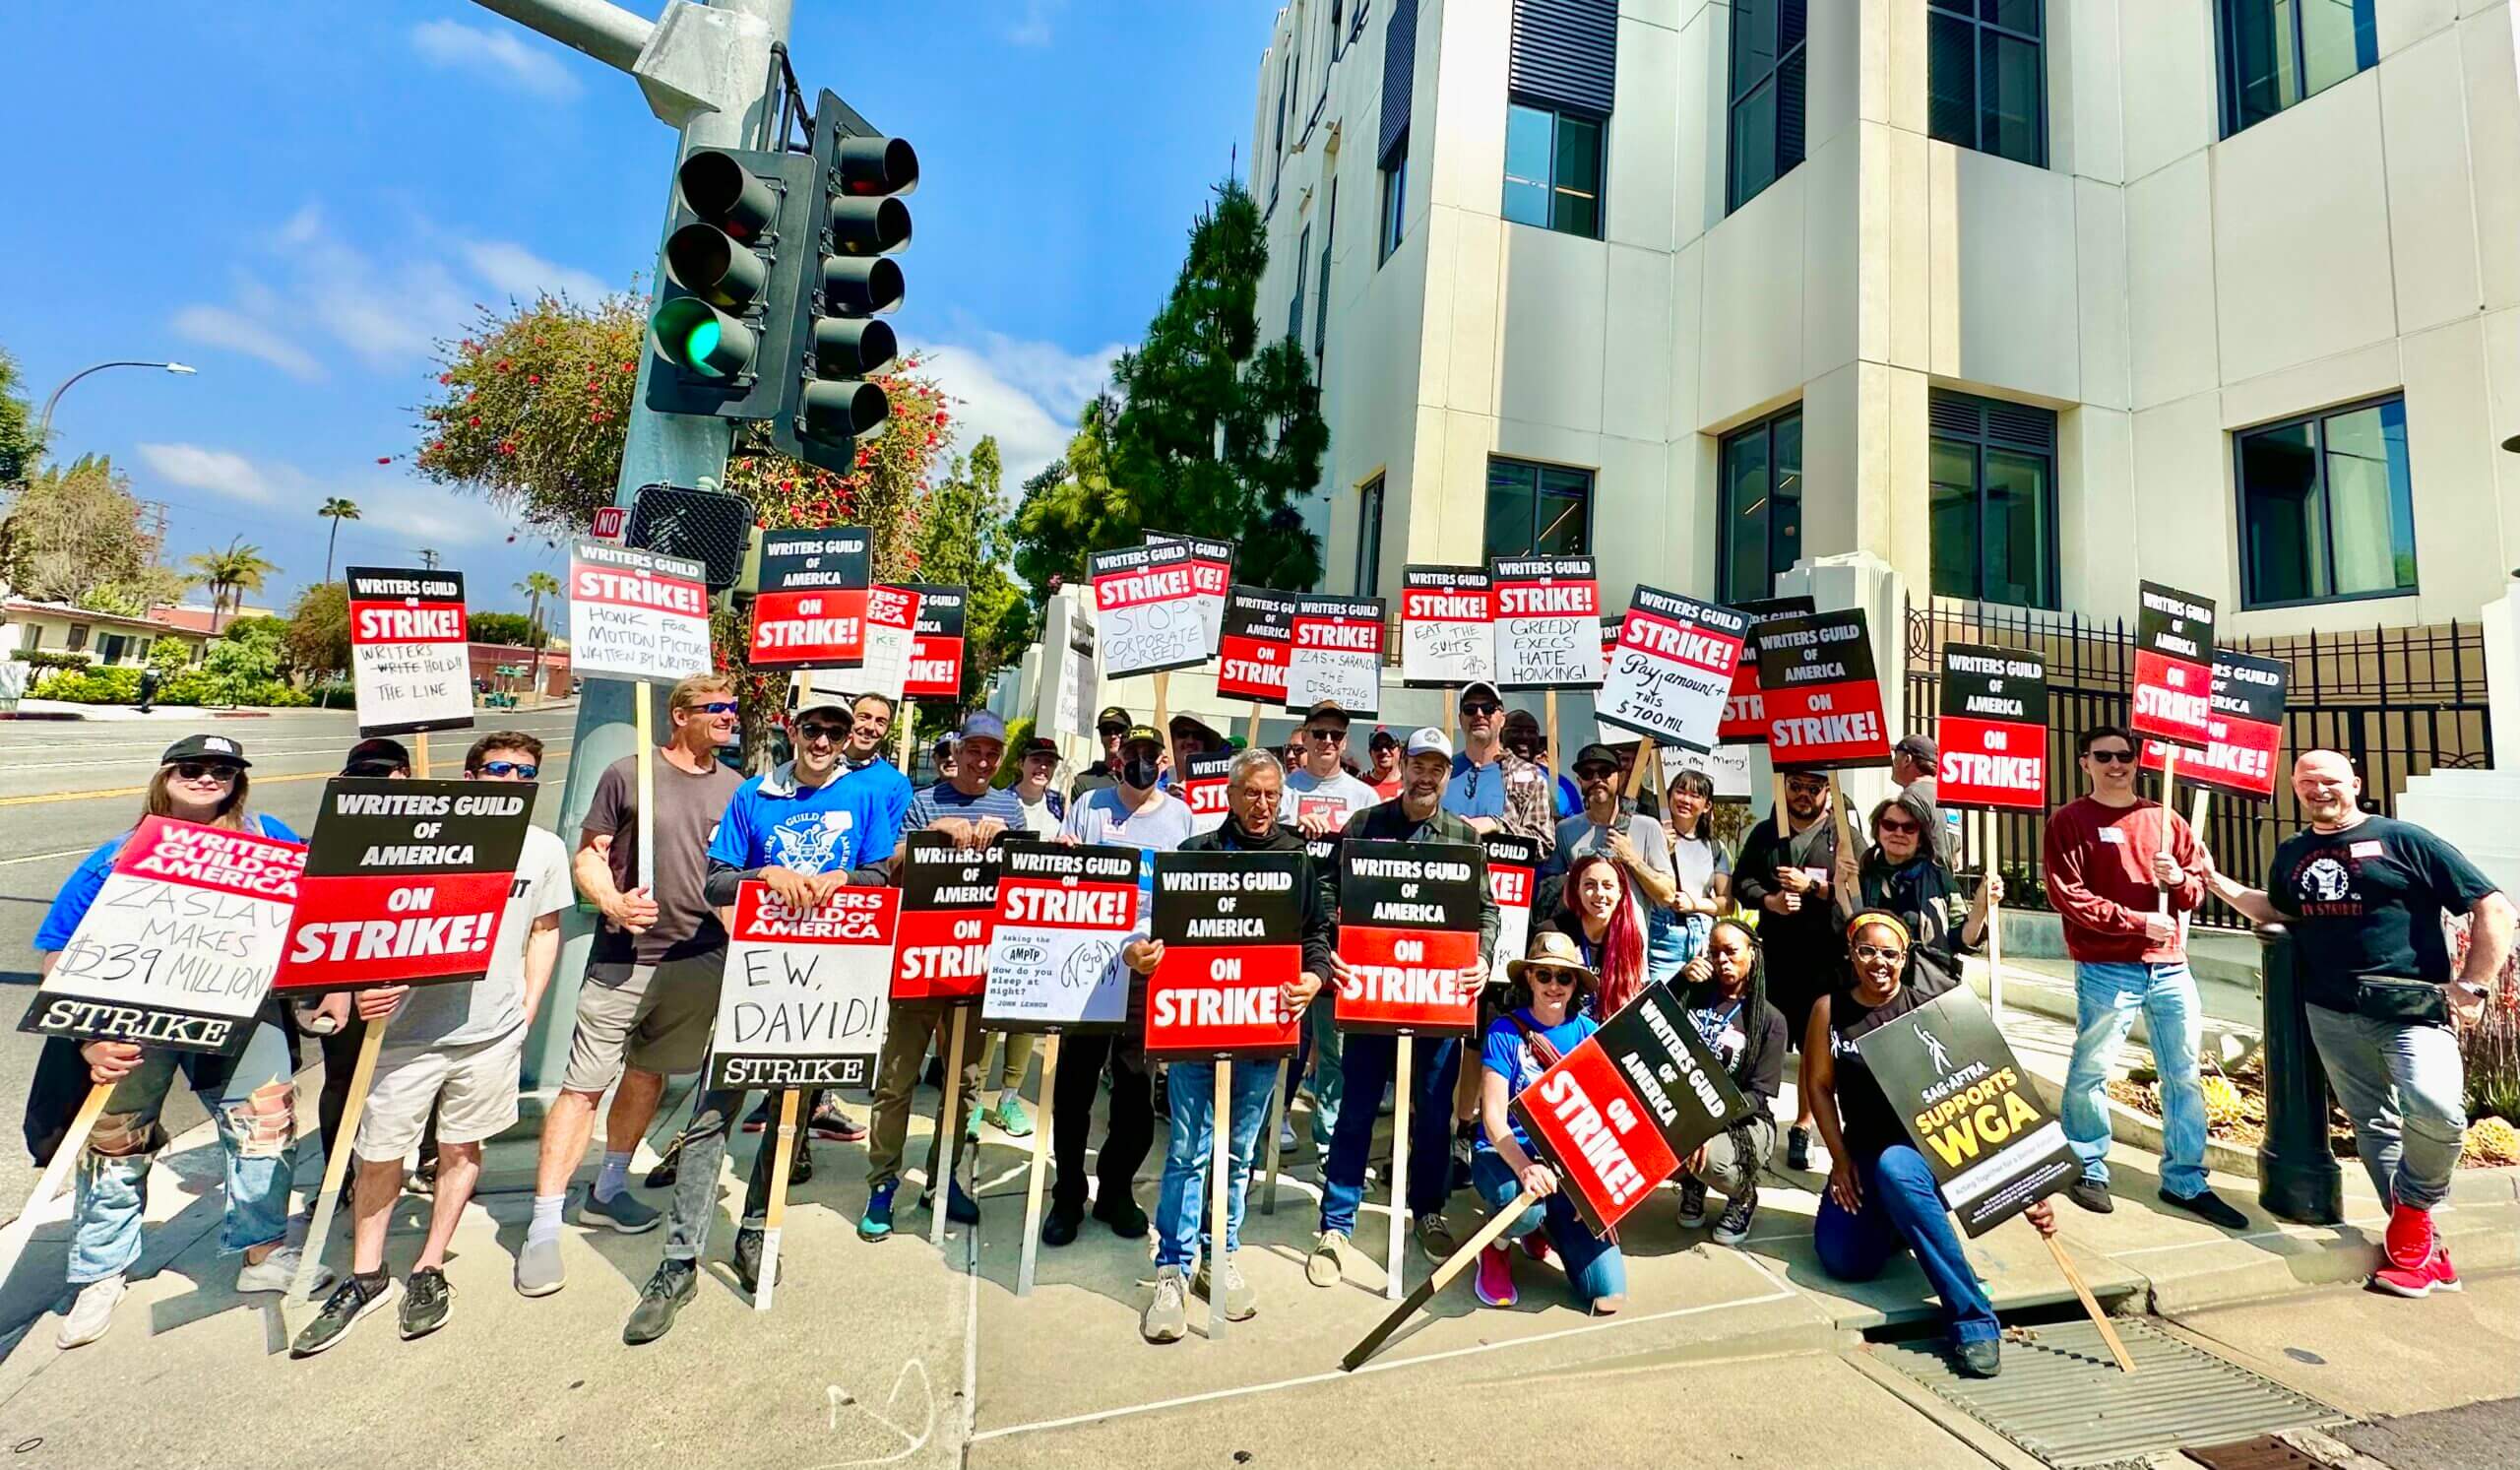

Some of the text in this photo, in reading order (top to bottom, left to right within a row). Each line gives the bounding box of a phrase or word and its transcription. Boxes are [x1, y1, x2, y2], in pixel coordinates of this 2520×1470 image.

[598, 512, 619, 534] NO
[767, 540, 863, 556] WRITERS GUILD
[1096, 545, 1186, 570] WRITERS GUILD
[1195, 543, 1228, 559] GUILD
[579, 544, 700, 578] WRITERS GUILD
[805, 557, 820, 569] OF
[1137, 564, 1150, 574] ON
[1498, 561, 1591, 576] WRITERS GUILD
[635, 568, 651, 578] ON
[782, 571, 842, 587] AMERICA
[1409, 572, 1487, 587] WRITERS GUILD
[1540, 577, 1552, 586] ON
[355, 578, 458, 596] WRITERS GUILD
[579, 572, 701, 614] STRIKE!
[1100, 569, 1191, 606] STRIKE!
[405, 598, 419, 607] ON
[797, 599, 823, 615] ON
[928, 595, 961, 607] GUILD
[1235, 596, 1280, 612] WRITERS
[1300, 602, 1347, 615] WRITERS
[1348, 604, 1379, 617] GUILD
[1409, 595, 1487, 619] STRIKE!
[1499, 587, 1593, 612] STRIKE!
[2142, 591, 2213, 624] WRITERS GUILD
[590, 606, 693, 634] HONK FOR
[1112, 600, 1190, 637] STOP
[1265, 613, 1277, 623] OF
[1639, 590, 1700, 617] WRITERS
[1700, 607, 1743, 631] GUILD
[359, 609, 461, 639] STRIKE!
[756, 616, 859, 649] STRIKE!
[1245, 623, 1291, 639] AMERICA
[1414, 622, 1480, 639] EAT THE
[1510, 618, 1581, 636] GREEDY
[1679, 618, 1693, 630] ON
[2172, 618, 2183, 633] OF
[589, 625, 655, 649] MOTION
[1103, 623, 1200, 660] CORPORATE
[1297, 622, 1377, 650] STRIKE!
[1513, 638, 1575, 650] EXECS
[1625, 617, 1735, 671] STRIKE!
[1759, 623, 1859, 652] WRITERS GUILD
[2154, 632, 2198, 658] AMERICA
[360, 645, 434, 661] WRITERS
[579, 645, 635, 665] WRITTEN
[640, 652, 655, 671] BY
[1120, 643, 1186, 671] GREED
[1256, 646, 1276, 661] ON
[1298, 650, 1328, 666] ZAS
[1429, 641, 1474, 656] SUITS
[1519, 650, 1566, 666] HATE
[1803, 648, 1819, 662] OF
[1512, 664, 1587, 682] HONKING!
[1785, 662, 1846, 683] AMERICA
[1947, 653, 2043, 679] WRITERS GUILD
[2233, 667, 2280, 686] GUILD
[1320, 671, 1346, 684] THE
[1988, 678, 2004, 693] OF
[2167, 667, 2185, 688] ON
[377, 682, 449, 701] THE LINE
[1305, 679, 1368, 699] DISGUSTING
[1634, 691, 1664, 708] THIS
[1807, 693, 1833, 712] ON
[1966, 696, 2024, 717] AMERICA
[2135, 683, 2208, 729] STRIKE!
[1664, 716, 1684, 734] MIL
[1772, 710, 1880, 747] STRIKE!
[1984, 731, 2007, 751] ON
[1941, 751, 2042, 792] STRIKE!
[337, 794, 525, 816] WRITERS GUILD
[785, 812, 820, 827] GUILD
[413, 821, 442, 840] OF
[161, 825, 307, 867] WRITERS
[359, 845, 474, 866] AMERICA
[914, 847, 983, 864] WRITERS
[1488, 842, 1529, 861] GUILD
[153, 842, 300, 881] GUILD OF
[1011, 852, 1084, 874] WRITERS
[1085, 859, 1132, 876] GUILD
[1351, 858, 1472, 881] WRITERS GUILD
[134, 857, 298, 898] AMERICA
[962, 867, 980, 882] OF
[1062, 875, 1079, 887] ON
[1162, 871, 1292, 891] WRITERS GUILD
[387, 887, 435, 912] ON
[1401, 883, 1419, 899] OF
[756, 904, 875, 924] GUILD OF
[1004, 886, 1128, 926] STRIKE!
[1217, 896, 1237, 913] OF
[1371, 902, 1446, 924] AMERICA
[140, 918, 257, 958] MAKES
[289, 912, 494, 964] STRIKE!
[745, 922, 881, 939] AMERICA
[953, 920, 982, 939] ON
[1185, 918, 1266, 938] AMERICA
[1394, 938, 1424, 962] ON
[165, 952, 273, 1000] MILLION
[743, 949, 823, 991] EW,
[992, 966, 1012, 975] How
[1035, 968, 1052, 978] you
[1210, 958, 1242, 981] ON
[990, 987, 1026, 997] night?
[991, 976, 1022, 987] sleep
[1343, 964, 1469, 1006] STRIKE!
[38, 999, 232, 1048] STRIKE
[734, 995, 879, 1044] DAVID!
[1639, 997, 1727, 1119] WRITERS GUILD
[724, 1057, 864, 1084] STRIKE
[1658, 1062, 1679, 1084] OF
[1620, 1052, 1679, 1127] AMERICA
[1915, 1066, 2019, 1134] SUPPORTS
[1606, 1097, 1639, 1135] ON
[1540, 1069, 1647, 1206] STRIKE!
[1925, 1089, 2043, 1170] WGA
